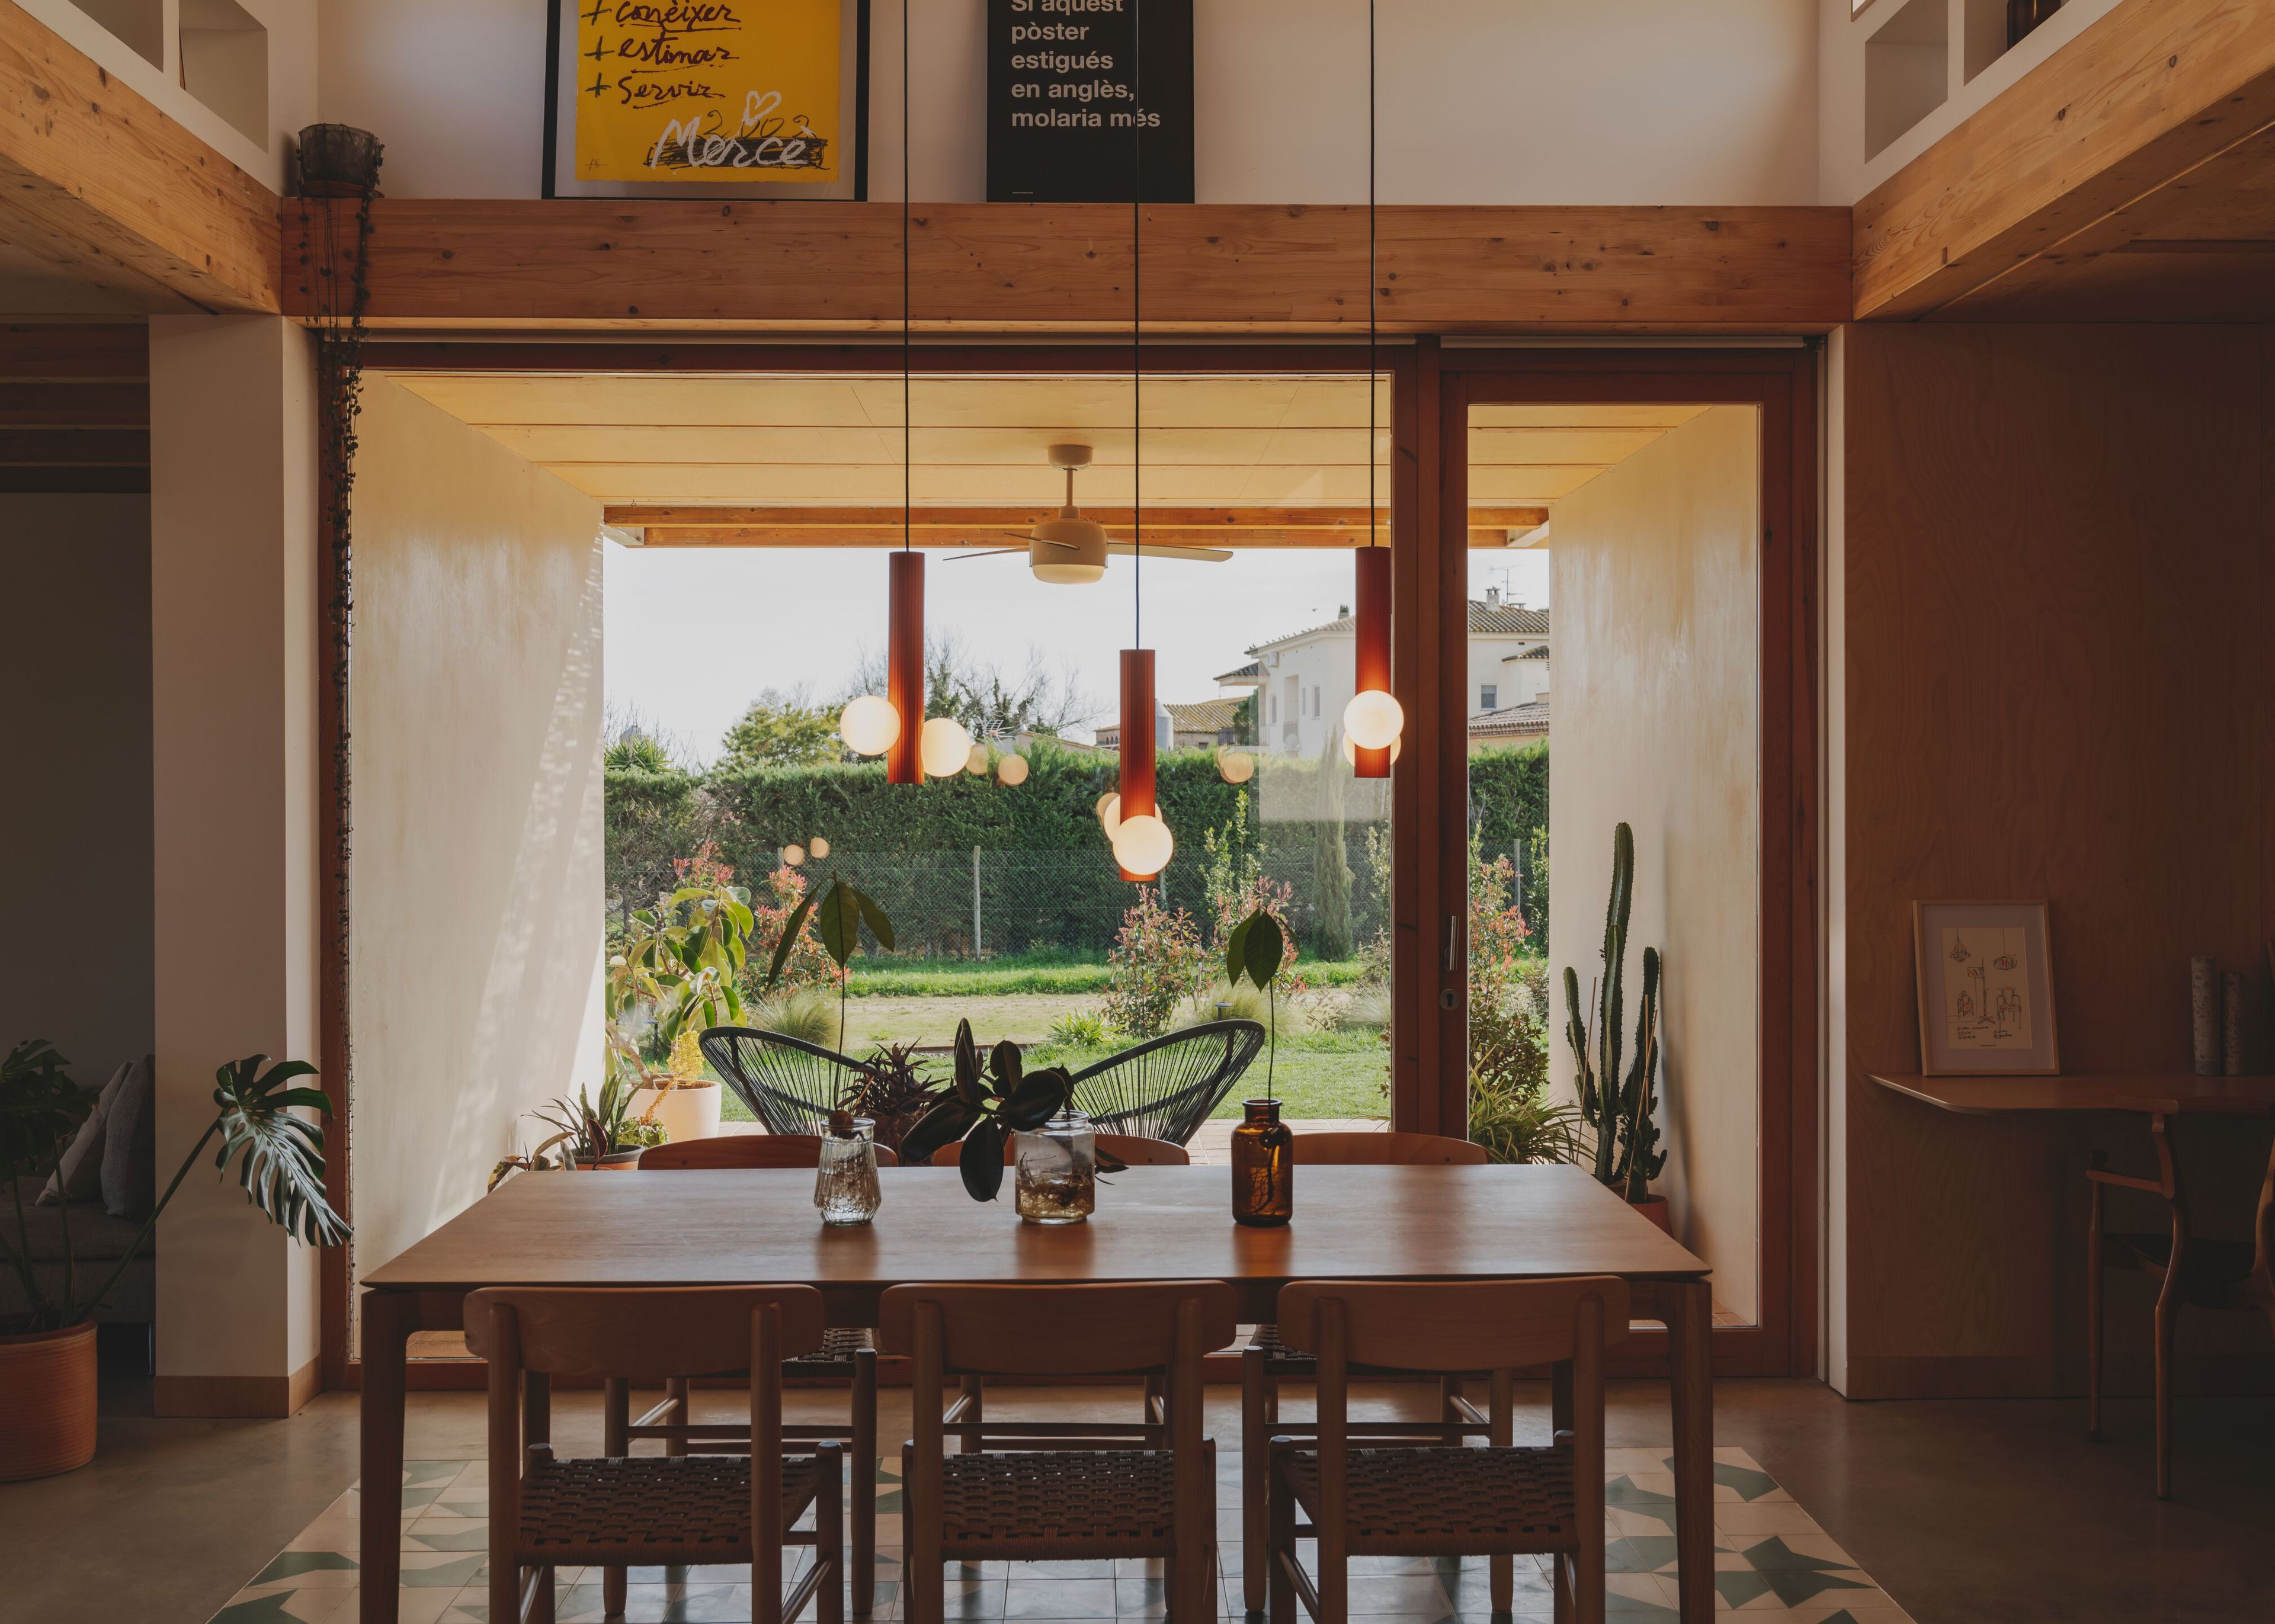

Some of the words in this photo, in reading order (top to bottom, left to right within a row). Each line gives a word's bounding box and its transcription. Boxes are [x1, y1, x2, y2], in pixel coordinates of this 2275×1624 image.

[1011, 0, 1033, 11] Si
[1041, 0, 1123, 16] aquest
[1012, 22, 1090, 44] pòster
[1011, 51, 1114, 73] estigués
[1011, 84, 1040, 98] en
[1048, 80, 1134, 102] anglès,
[1012, 108, 1102, 127] molaria
[1110, 109, 1161, 127] més
